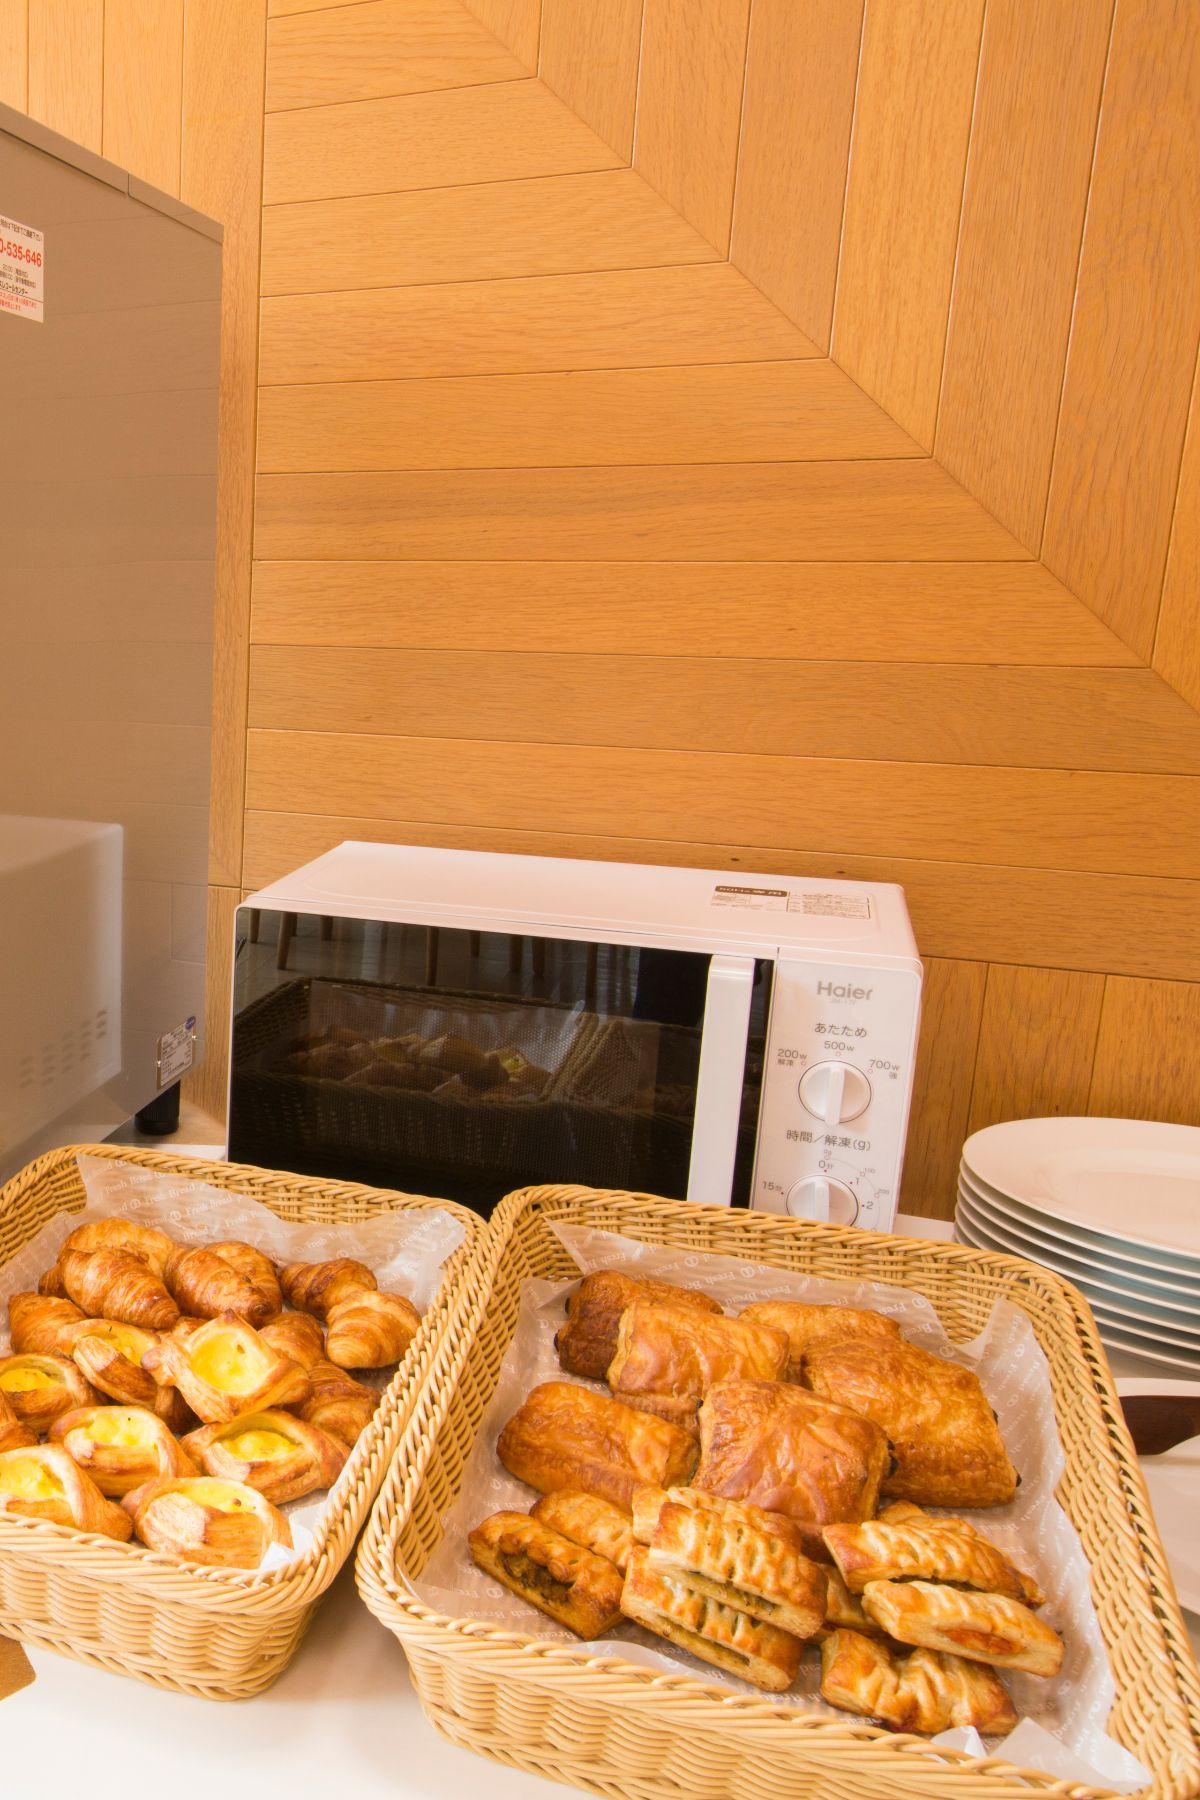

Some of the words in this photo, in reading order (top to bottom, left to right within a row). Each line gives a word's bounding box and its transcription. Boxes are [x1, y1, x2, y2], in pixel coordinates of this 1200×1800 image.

[816, 980, 874, 1001] Haier
[814, 1022, 867, 1038] あたため
[761, 1180, 782, 1192] 15分
[865, 1201, 874, 1210] 2
